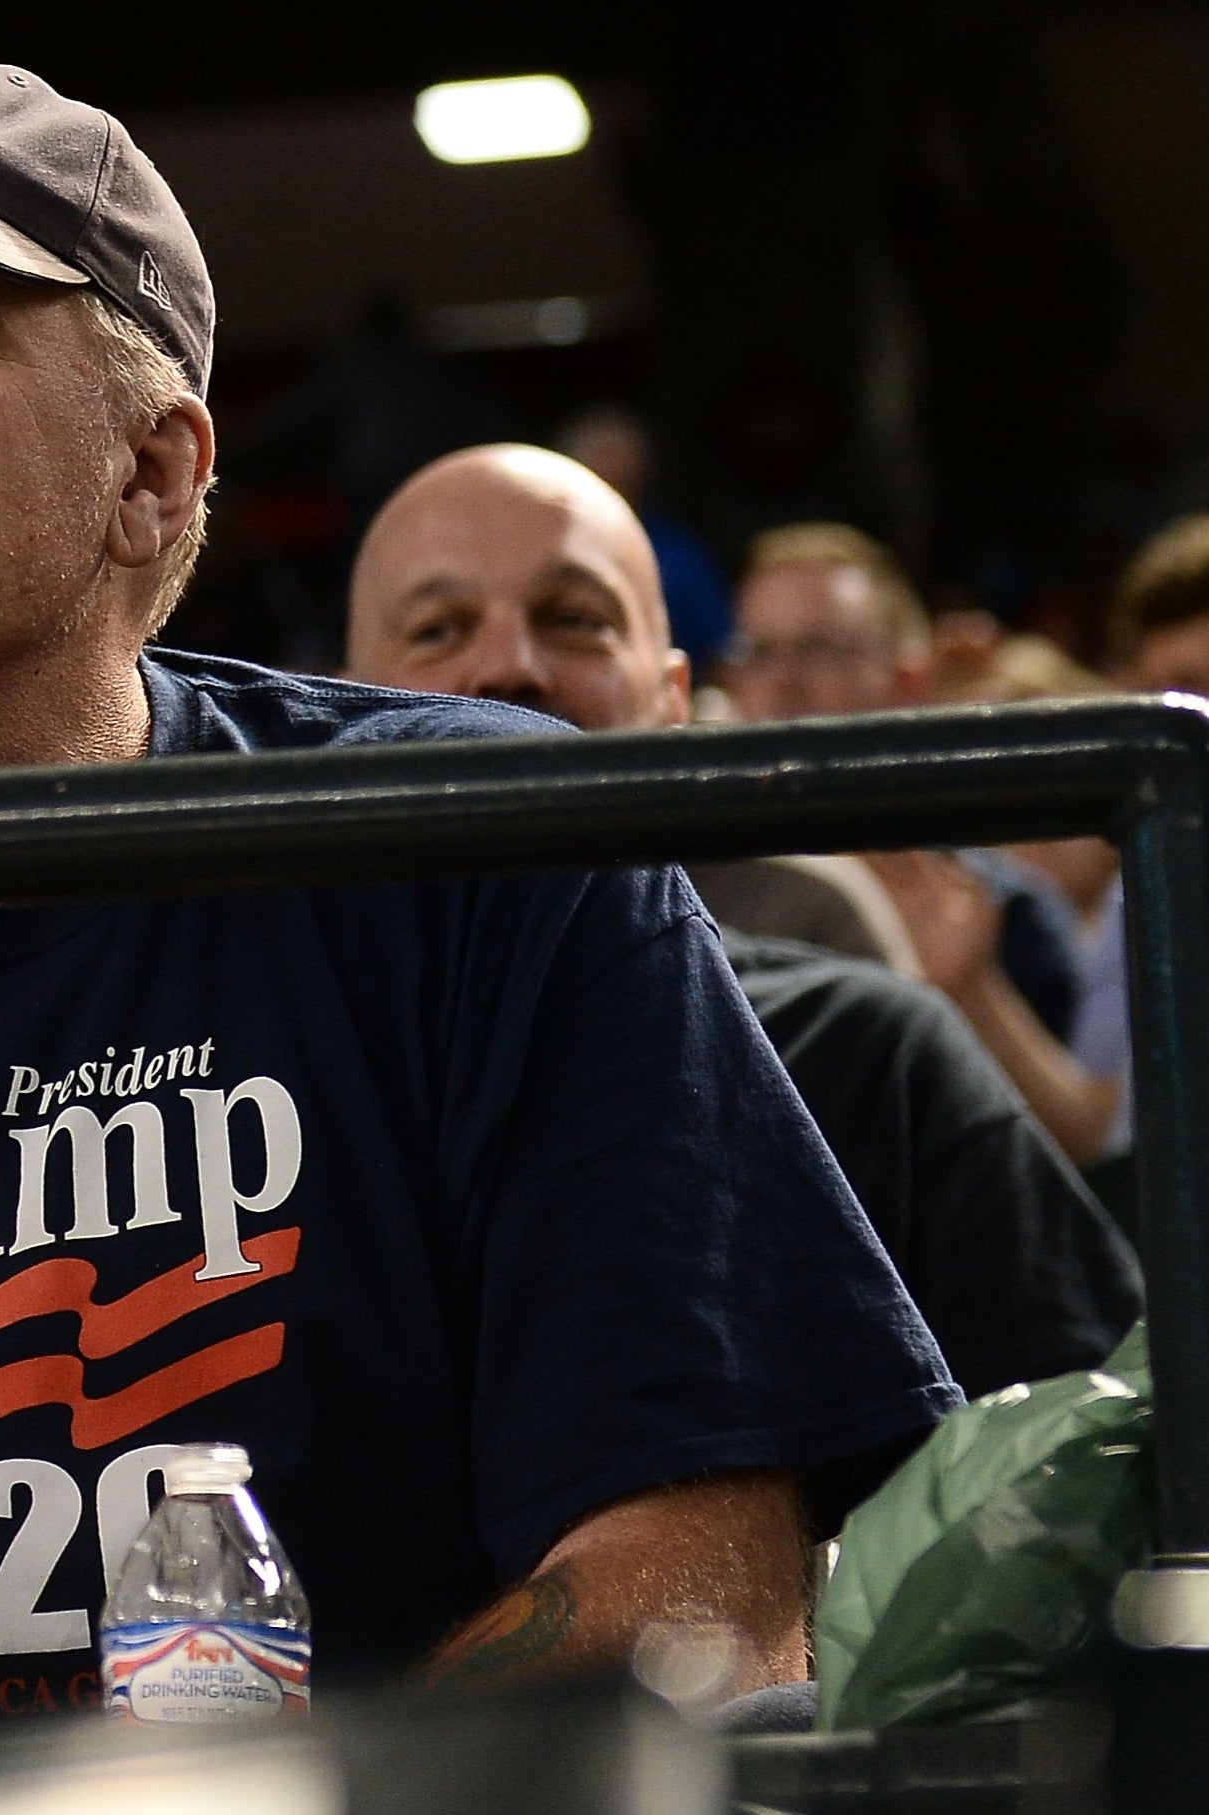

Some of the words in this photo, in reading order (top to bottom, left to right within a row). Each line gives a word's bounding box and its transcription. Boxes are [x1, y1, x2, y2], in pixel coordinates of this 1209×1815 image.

[1, 1036, 215, 1117] President
[171, 1667, 244, 1684] PURIFIED
[141, 1683, 220, 1699] DRINKING
[222, 1686, 271, 1702] WATER
